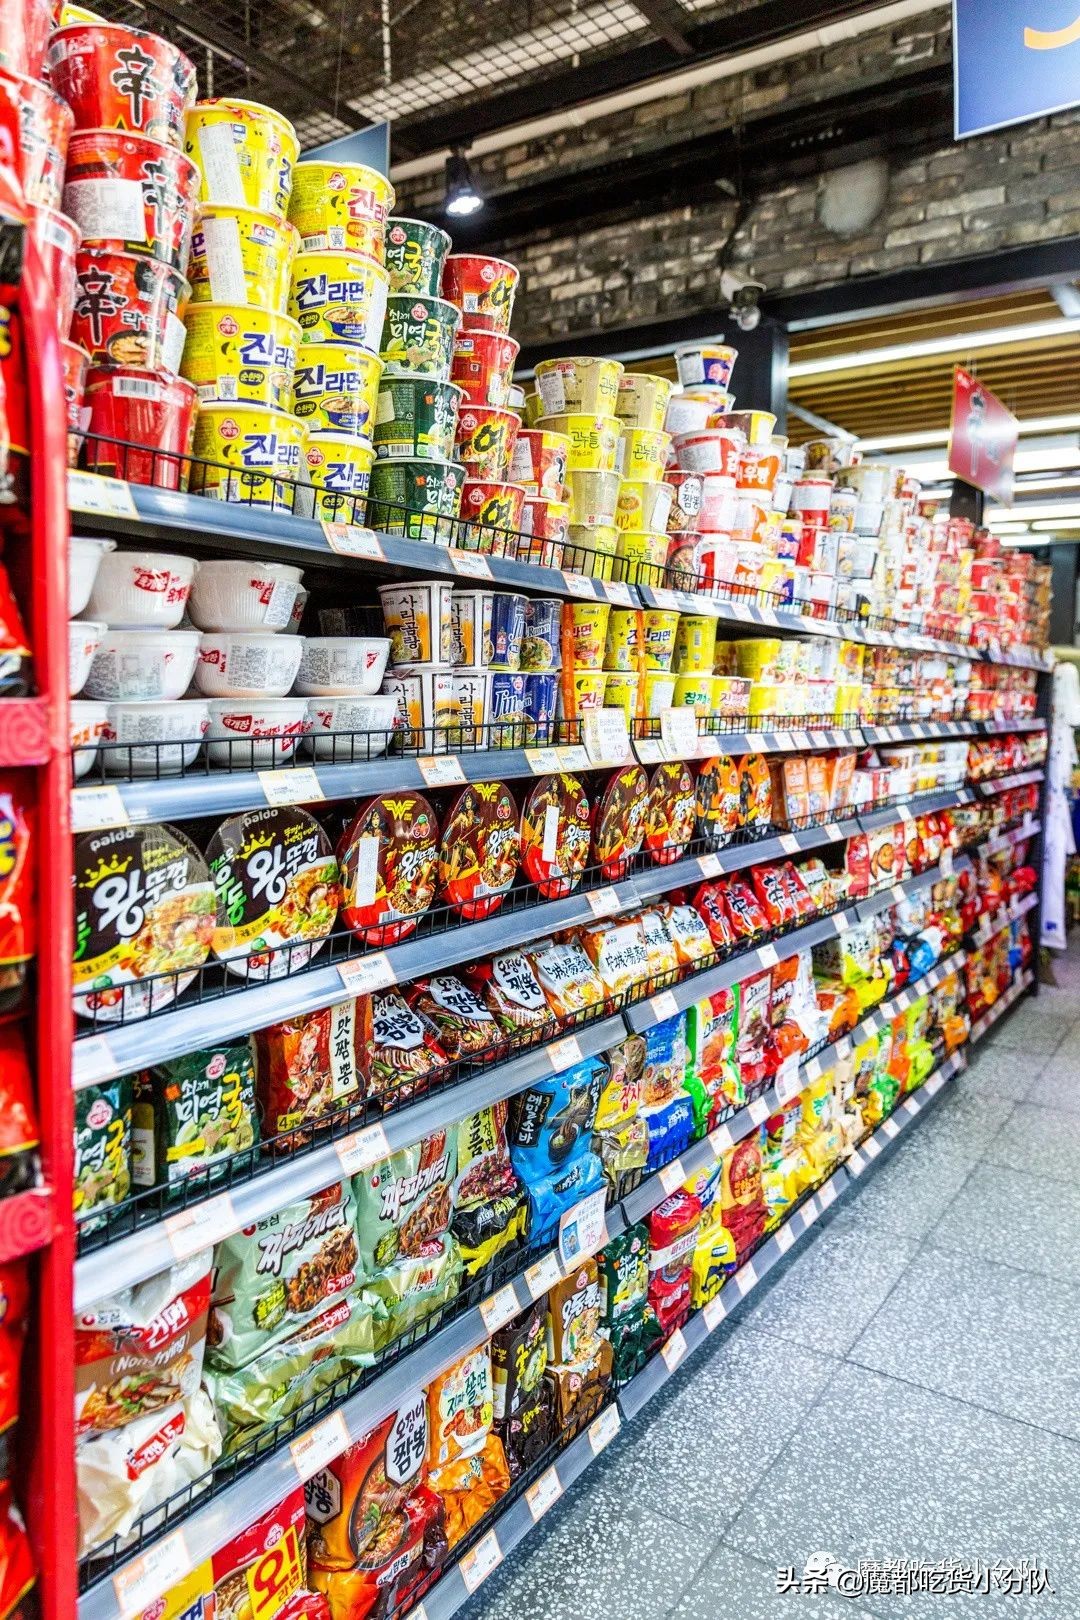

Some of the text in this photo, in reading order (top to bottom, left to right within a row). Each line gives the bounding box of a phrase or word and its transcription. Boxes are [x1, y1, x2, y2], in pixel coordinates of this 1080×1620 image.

[111, 44, 160, 127] 辛
[75, 267, 127, 346] 辛
[295, 275, 364, 311] 진라면
[293, 365, 360, 398] 진라면
[399, 595, 421, 650] 사리곰탕
[458, 682, 477, 734] 사리곰탕
[90, 829, 136, 852] paldo
[243, 808, 279, 828] paldo
[247, 834, 320, 904] 왕뚜껑
[93, 857, 190, 937] 왕뚜껑
[507, 972, 541, 1001] 짬뽕
[334, 1016, 354, 1088] 맛짬뽕
[175, 1073, 243, 1129] 미역국
[379, 1152, 451, 1222] 짜파게티
[256, 1196, 352, 1277] 짜파게티
[257, 1214, 280, 1231] 농심
[393, 1421, 427, 1477] 짬뽕
[396, 1399, 426, 1444] 오징어
